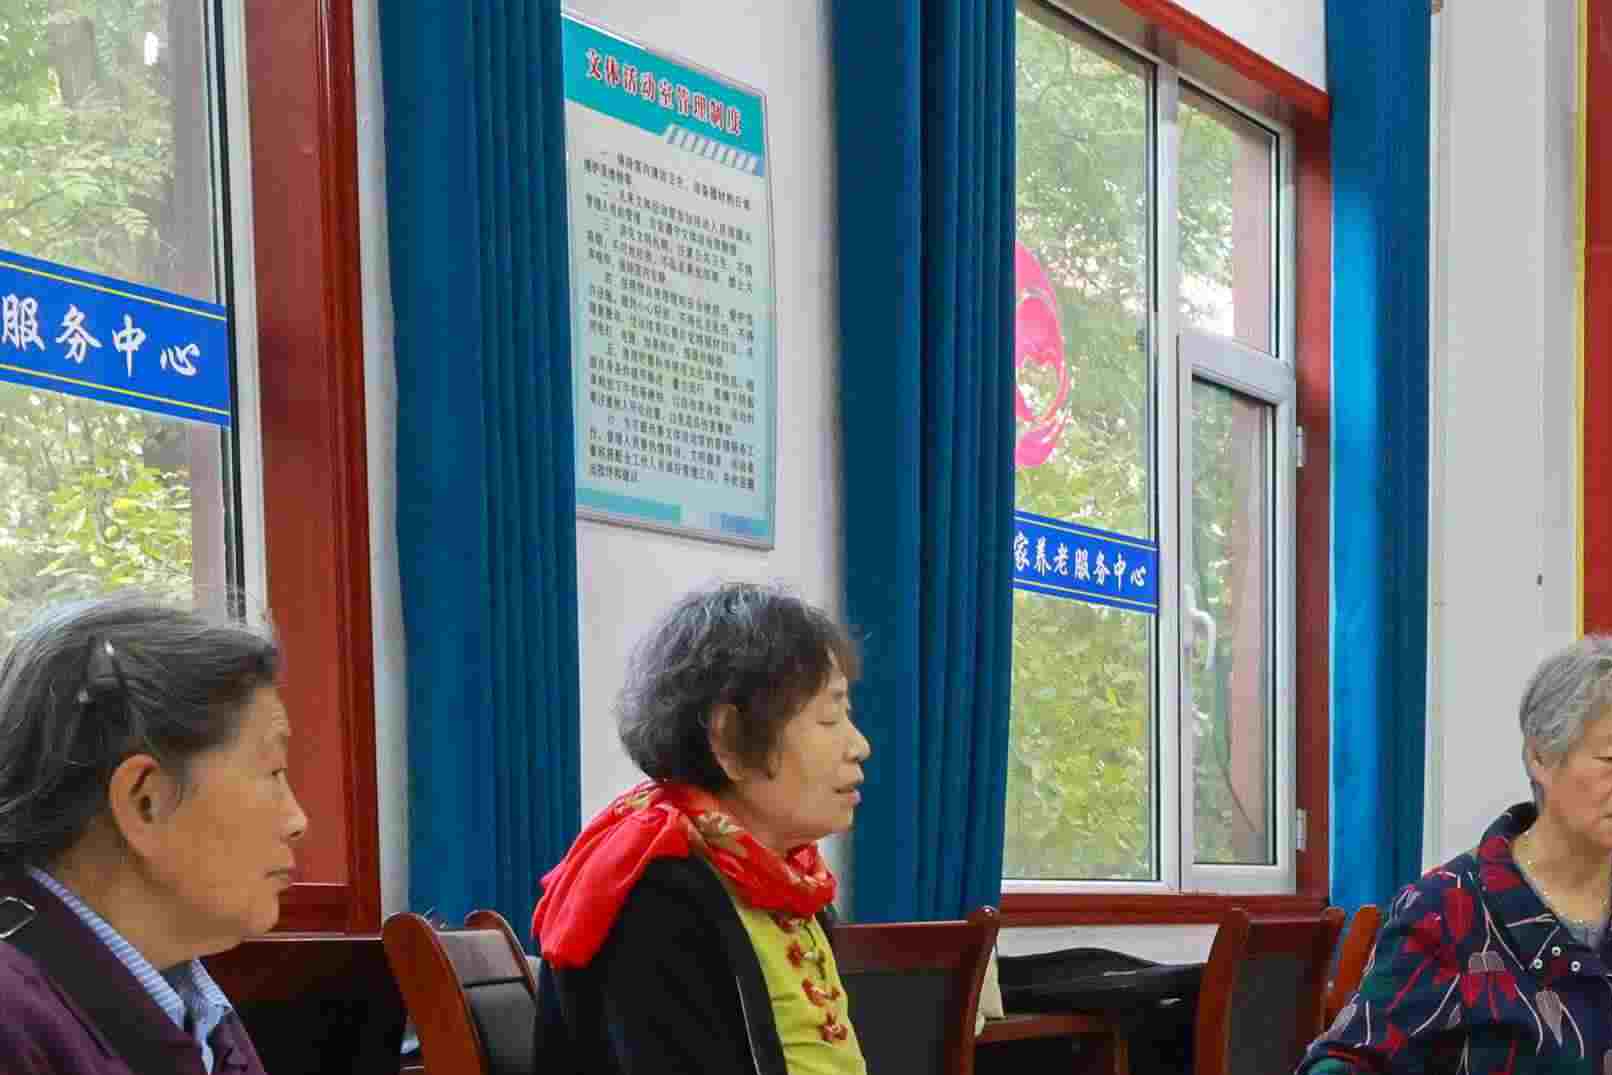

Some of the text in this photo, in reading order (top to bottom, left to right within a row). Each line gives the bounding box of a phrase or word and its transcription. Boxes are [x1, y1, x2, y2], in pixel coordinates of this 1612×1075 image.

[1, 293, 201, 377] 服务中心
[1014, 531, 1147, 592] 家养老服务中心
